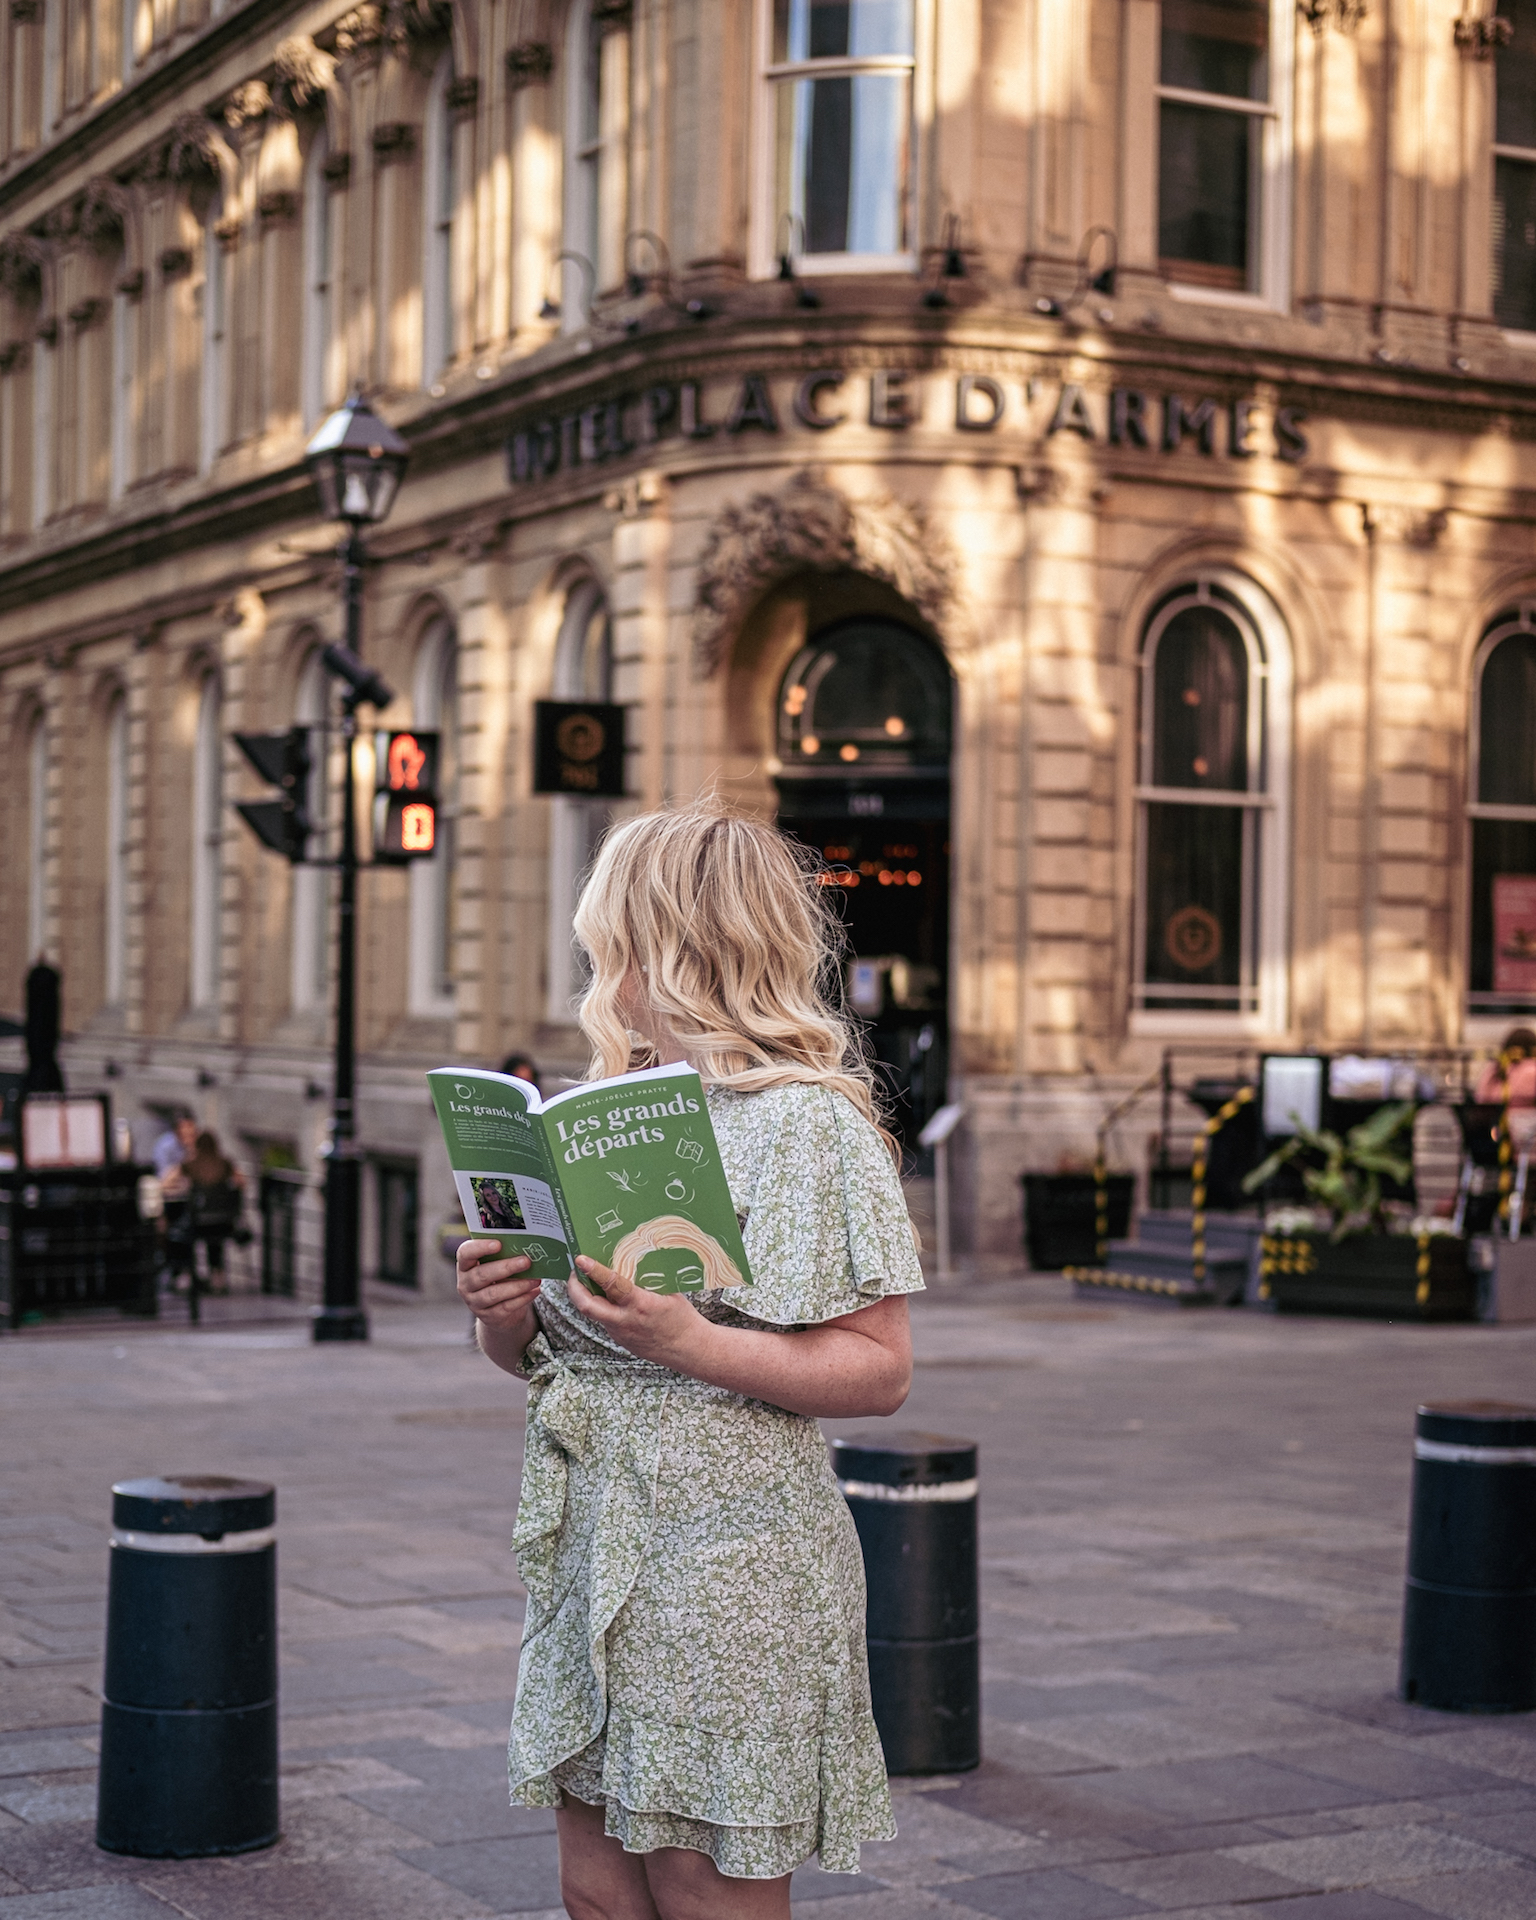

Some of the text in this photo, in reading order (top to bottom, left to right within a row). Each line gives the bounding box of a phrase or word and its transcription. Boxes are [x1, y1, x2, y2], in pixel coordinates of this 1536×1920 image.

[641, 369, 914, 441] PLACE
[955, 374, 1308, 461] D'ARMES
[449, 1100, 471, 1112] Les
[473, 1105, 513, 1119] grands
[555, 1114, 602, 1144] Les
[606, 1092, 700, 1133] grands
[575, 1086, 668, 1110] MARIE-JOËLLE PRATTE
[562, 1123, 665, 1165] départs
